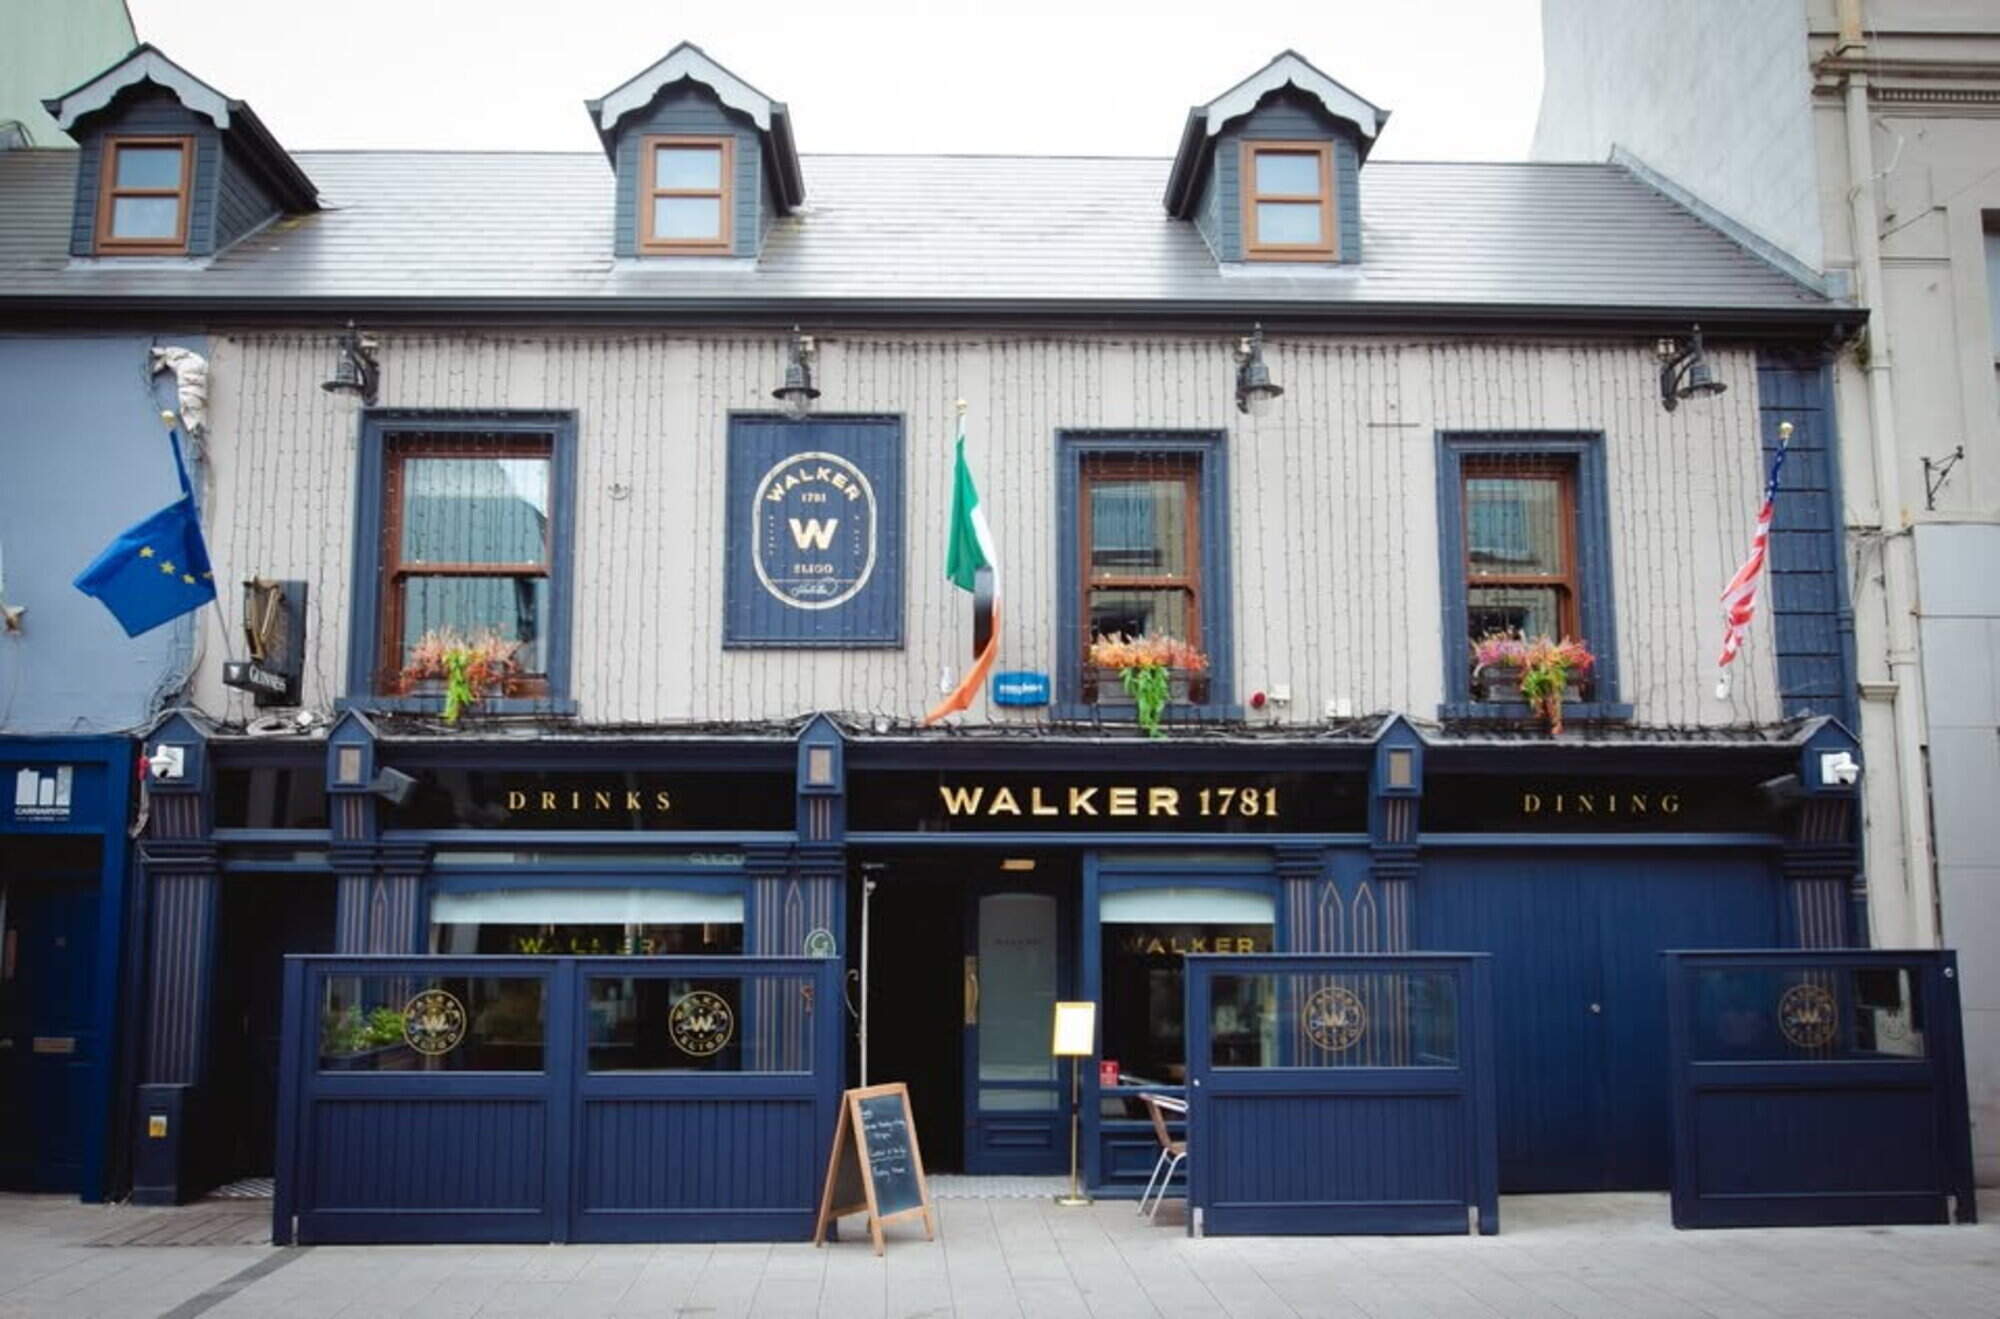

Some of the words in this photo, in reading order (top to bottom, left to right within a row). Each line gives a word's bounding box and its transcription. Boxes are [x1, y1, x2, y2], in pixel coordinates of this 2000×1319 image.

[766, 466, 861, 502] WALKER
[788, 518, 839, 550] W
[508, 791, 671, 810] DRINKS
[940, 787, 1180, 816] WALKER
[1199, 788, 1278, 816] 1781
[1524, 794, 1680, 813] DINING
[519, 938, 655, 953] WLER
